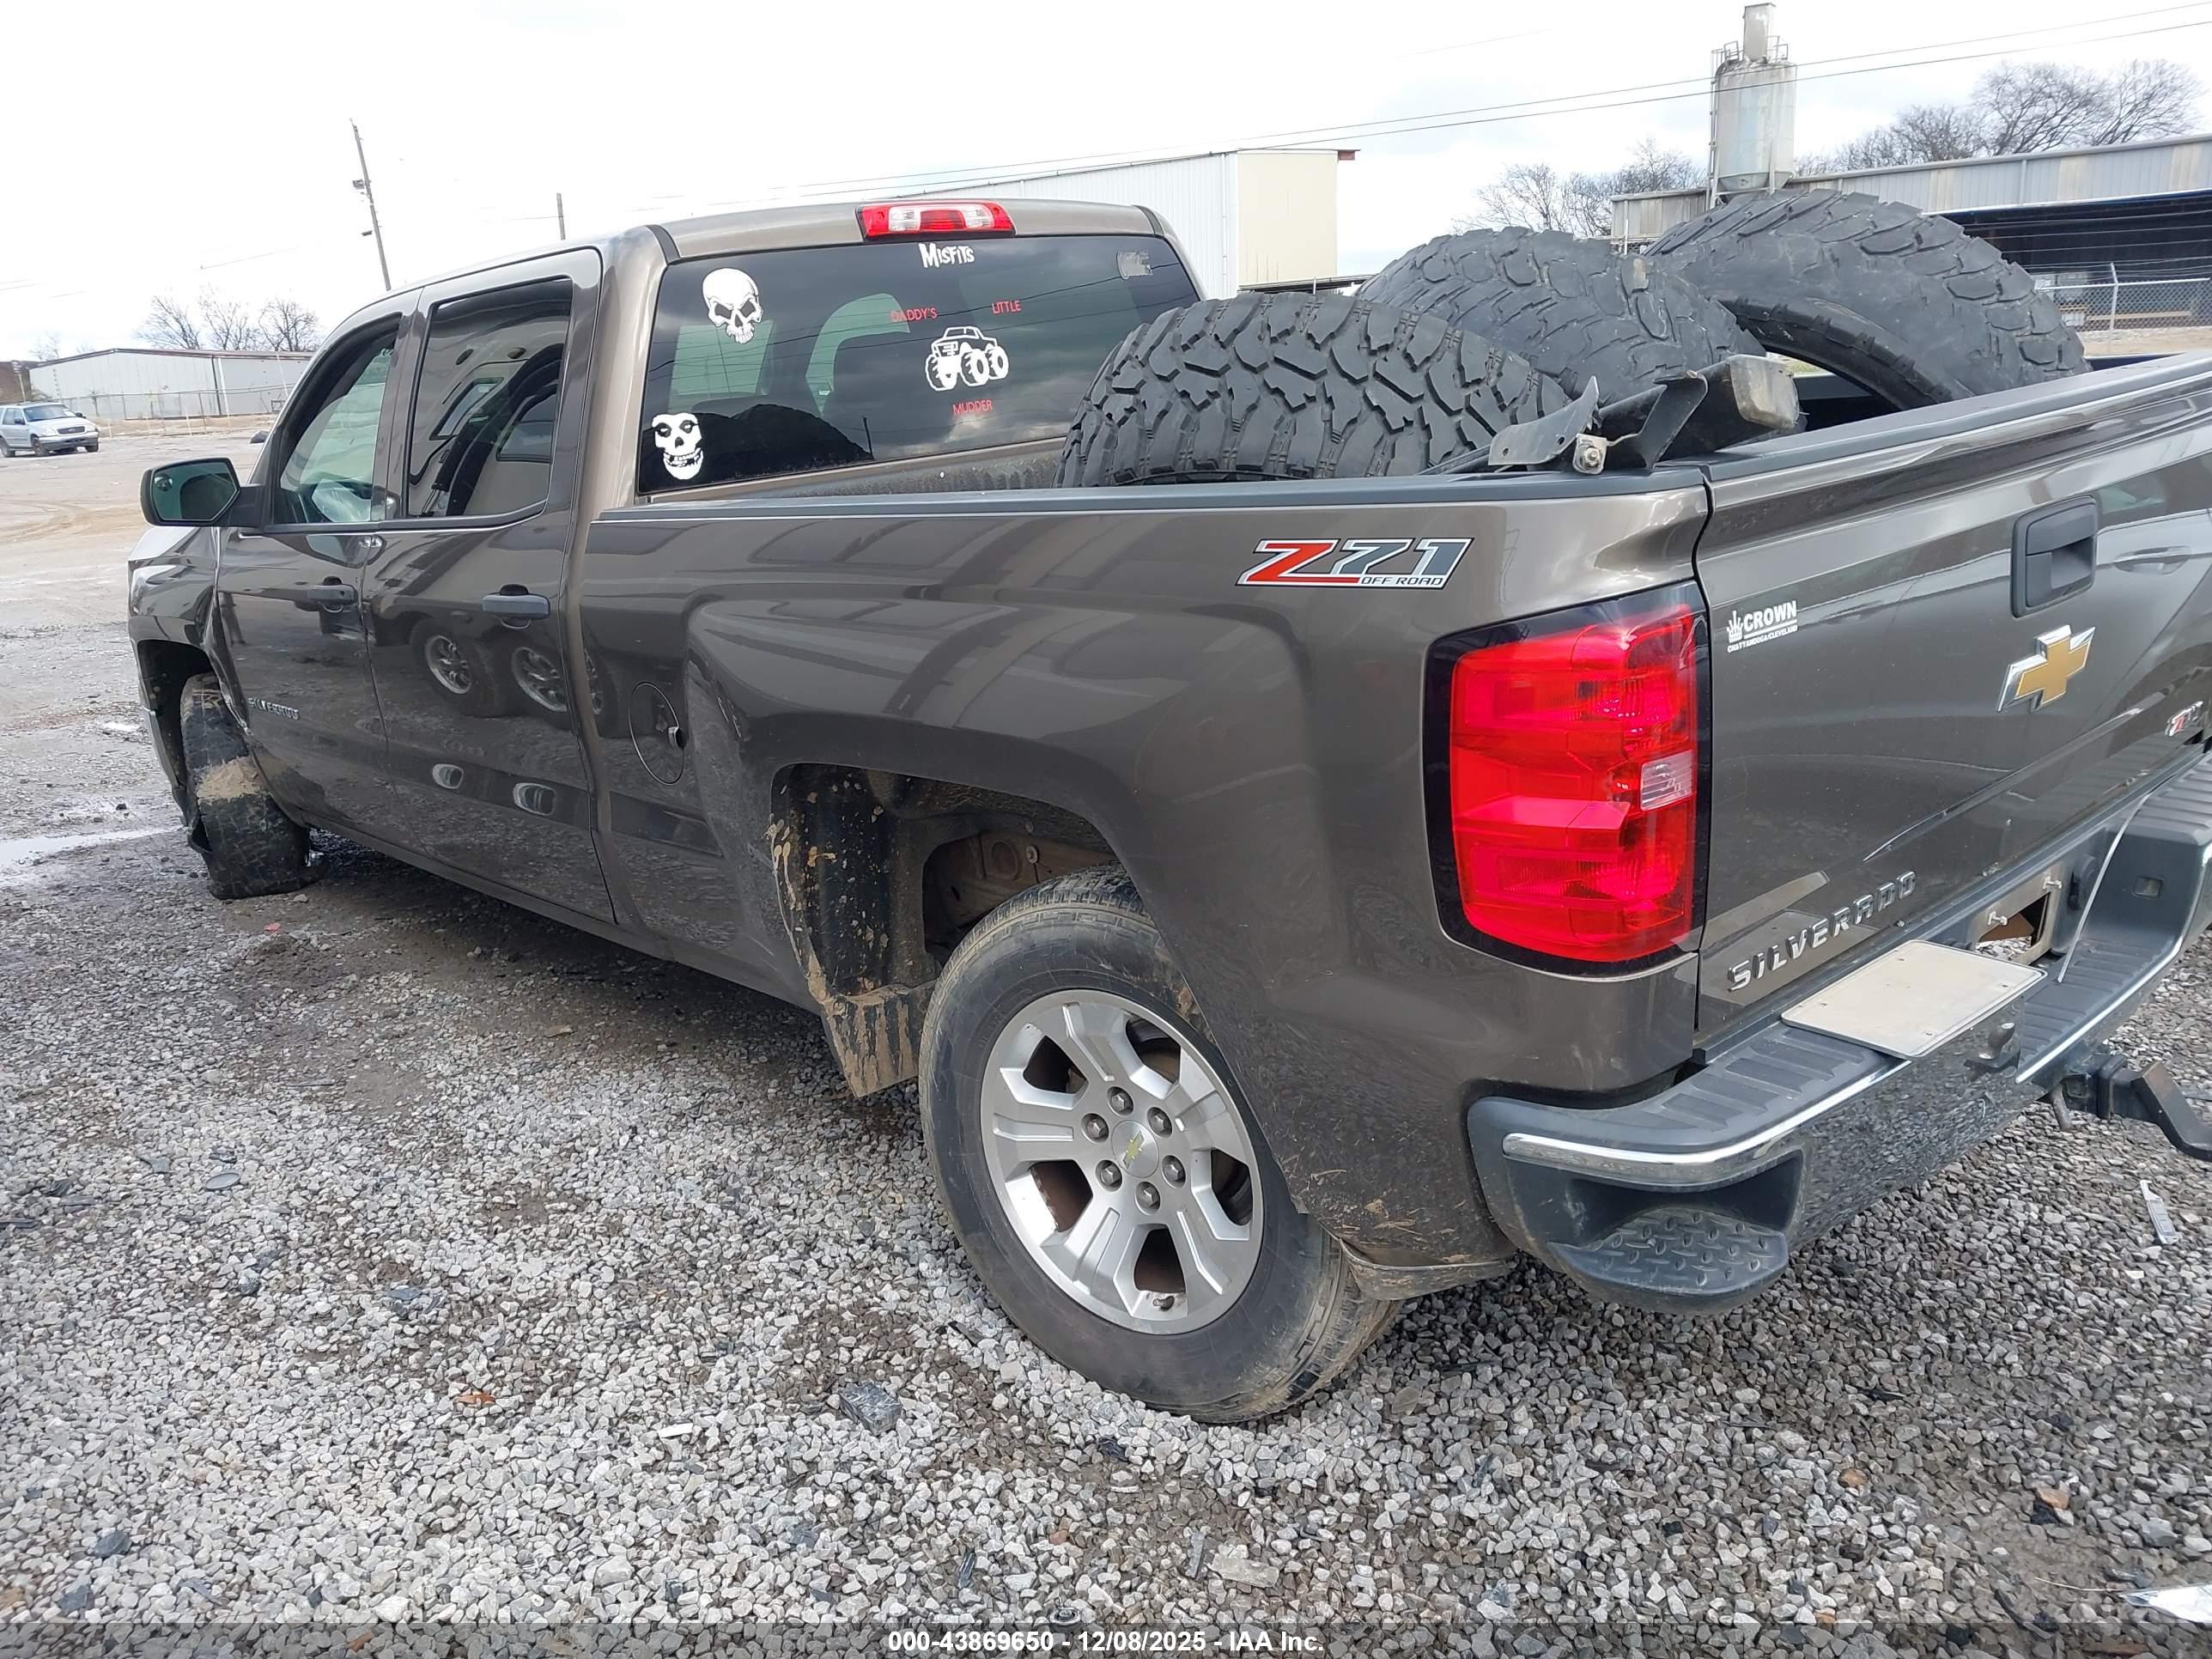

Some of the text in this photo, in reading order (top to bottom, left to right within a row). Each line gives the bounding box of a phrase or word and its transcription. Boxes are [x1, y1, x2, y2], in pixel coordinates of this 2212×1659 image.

[890, 300, 1022, 322] DADDY'S LITTLE
[952, 399, 993, 415] MUDDER
[1236, 537, 1475, 589] Z71
[1360, 576, 1443, 586] OFF ROAD
[1743, 599, 1797, 632] CROWN
[1727, 870, 1917, 992] SILVERADO
